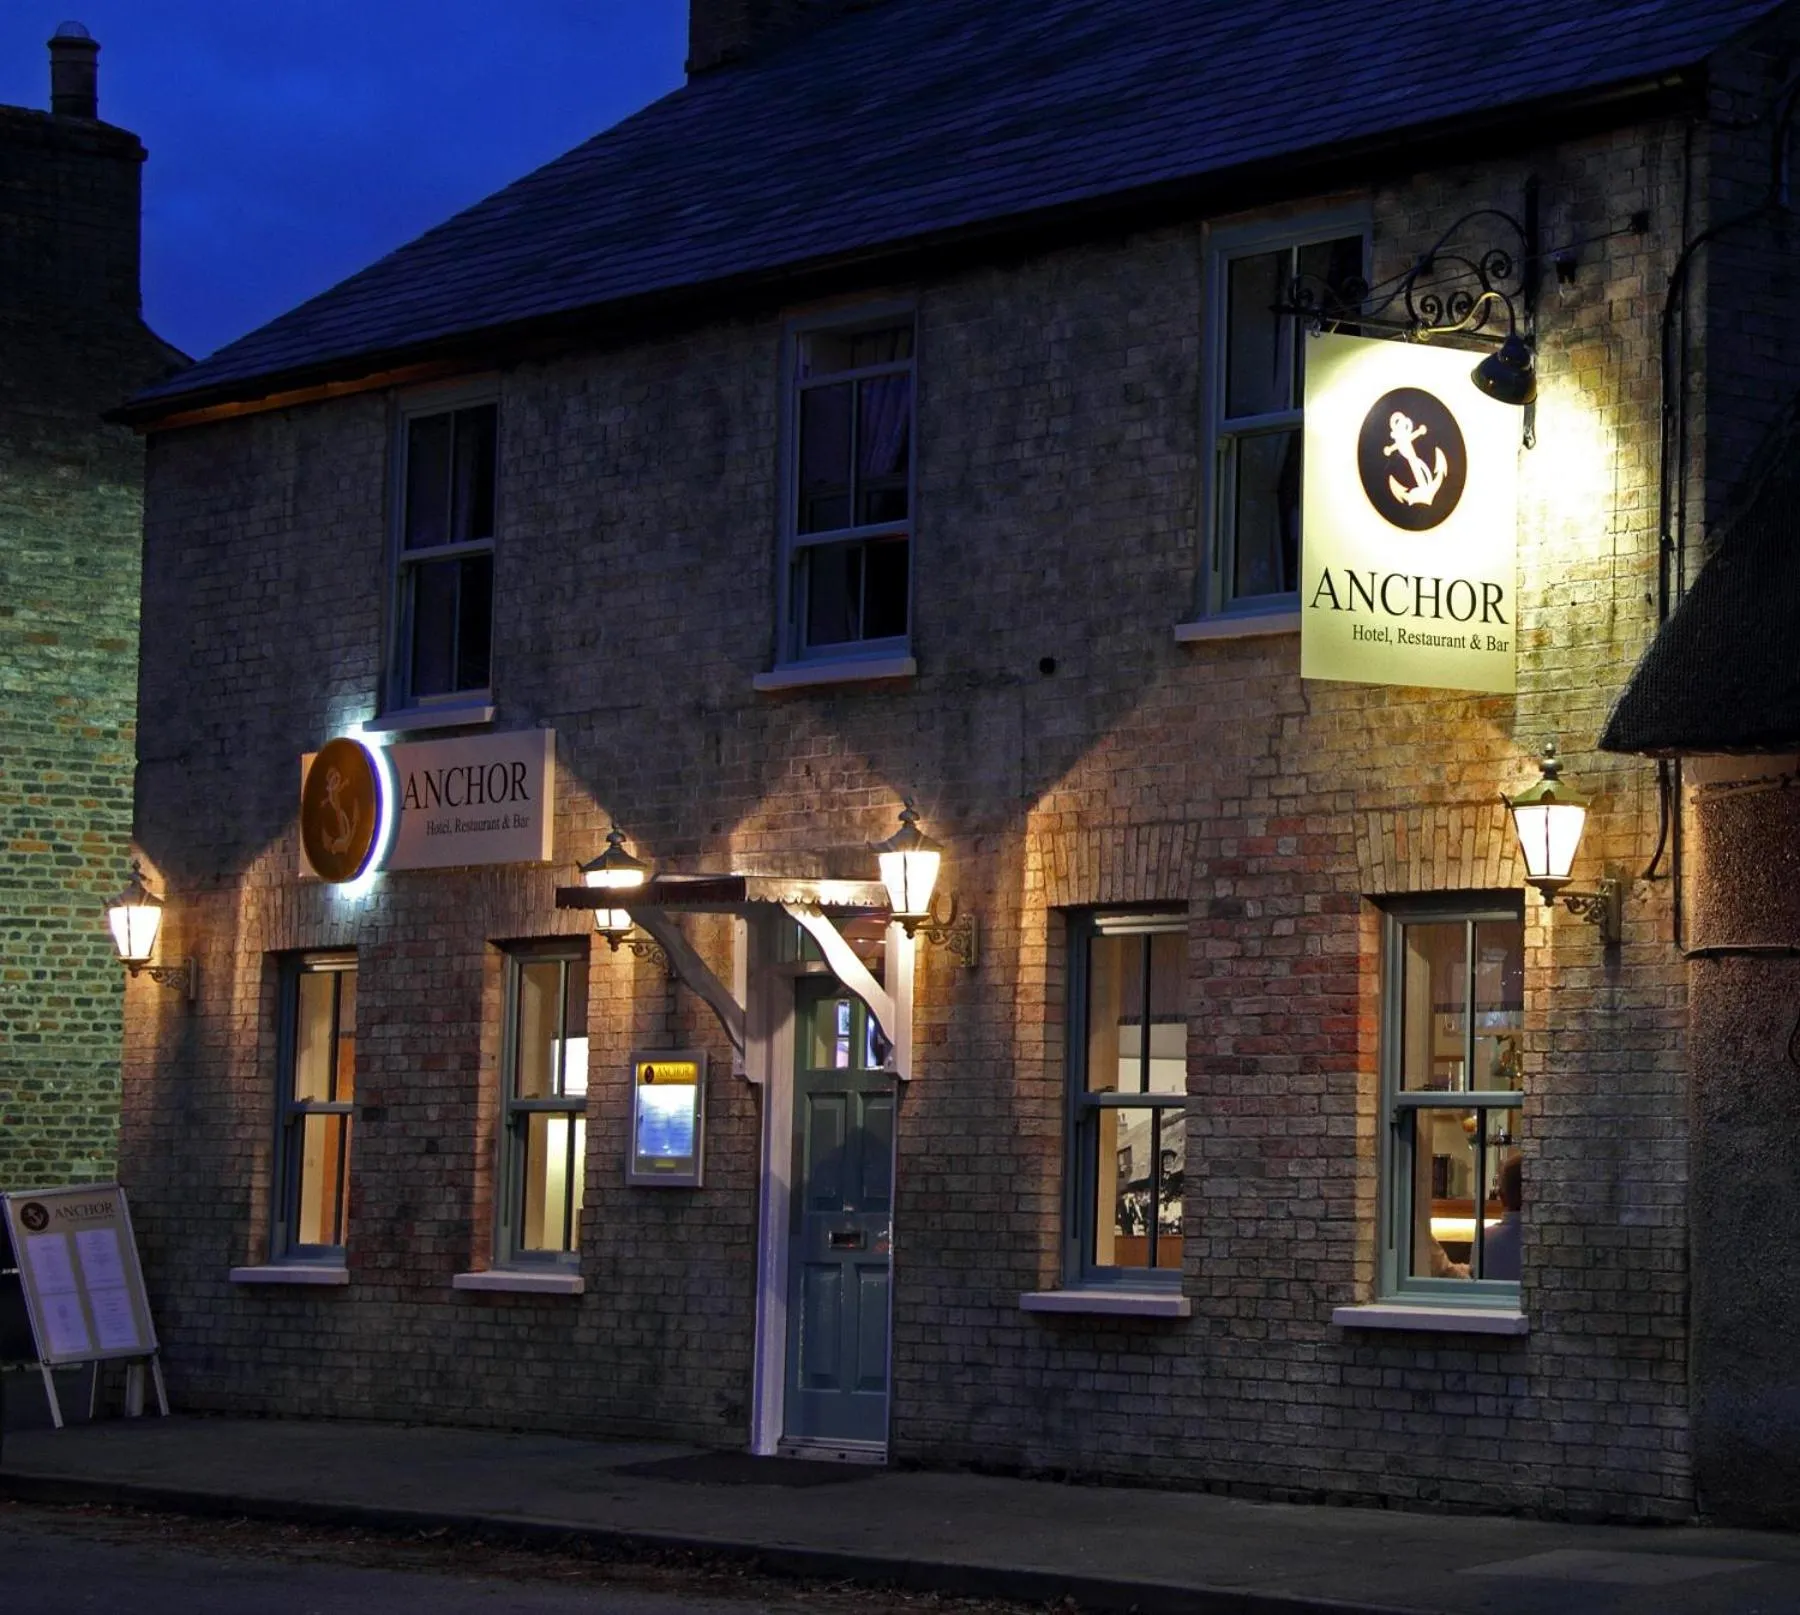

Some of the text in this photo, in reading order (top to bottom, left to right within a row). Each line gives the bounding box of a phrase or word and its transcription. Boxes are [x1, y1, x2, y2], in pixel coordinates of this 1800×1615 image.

[1309, 567, 1509, 624] ANCHOR
[1352, 624, 1509, 652] Hotel, Restaurant & Bar
[402, 762, 529, 810] ANCHOR
[455, 815, 500, 833] Restaurant
[502, 814, 510, 829] &
[513, 814, 530, 829] Bar
[54, 1201, 115, 1218] ANCHOR
